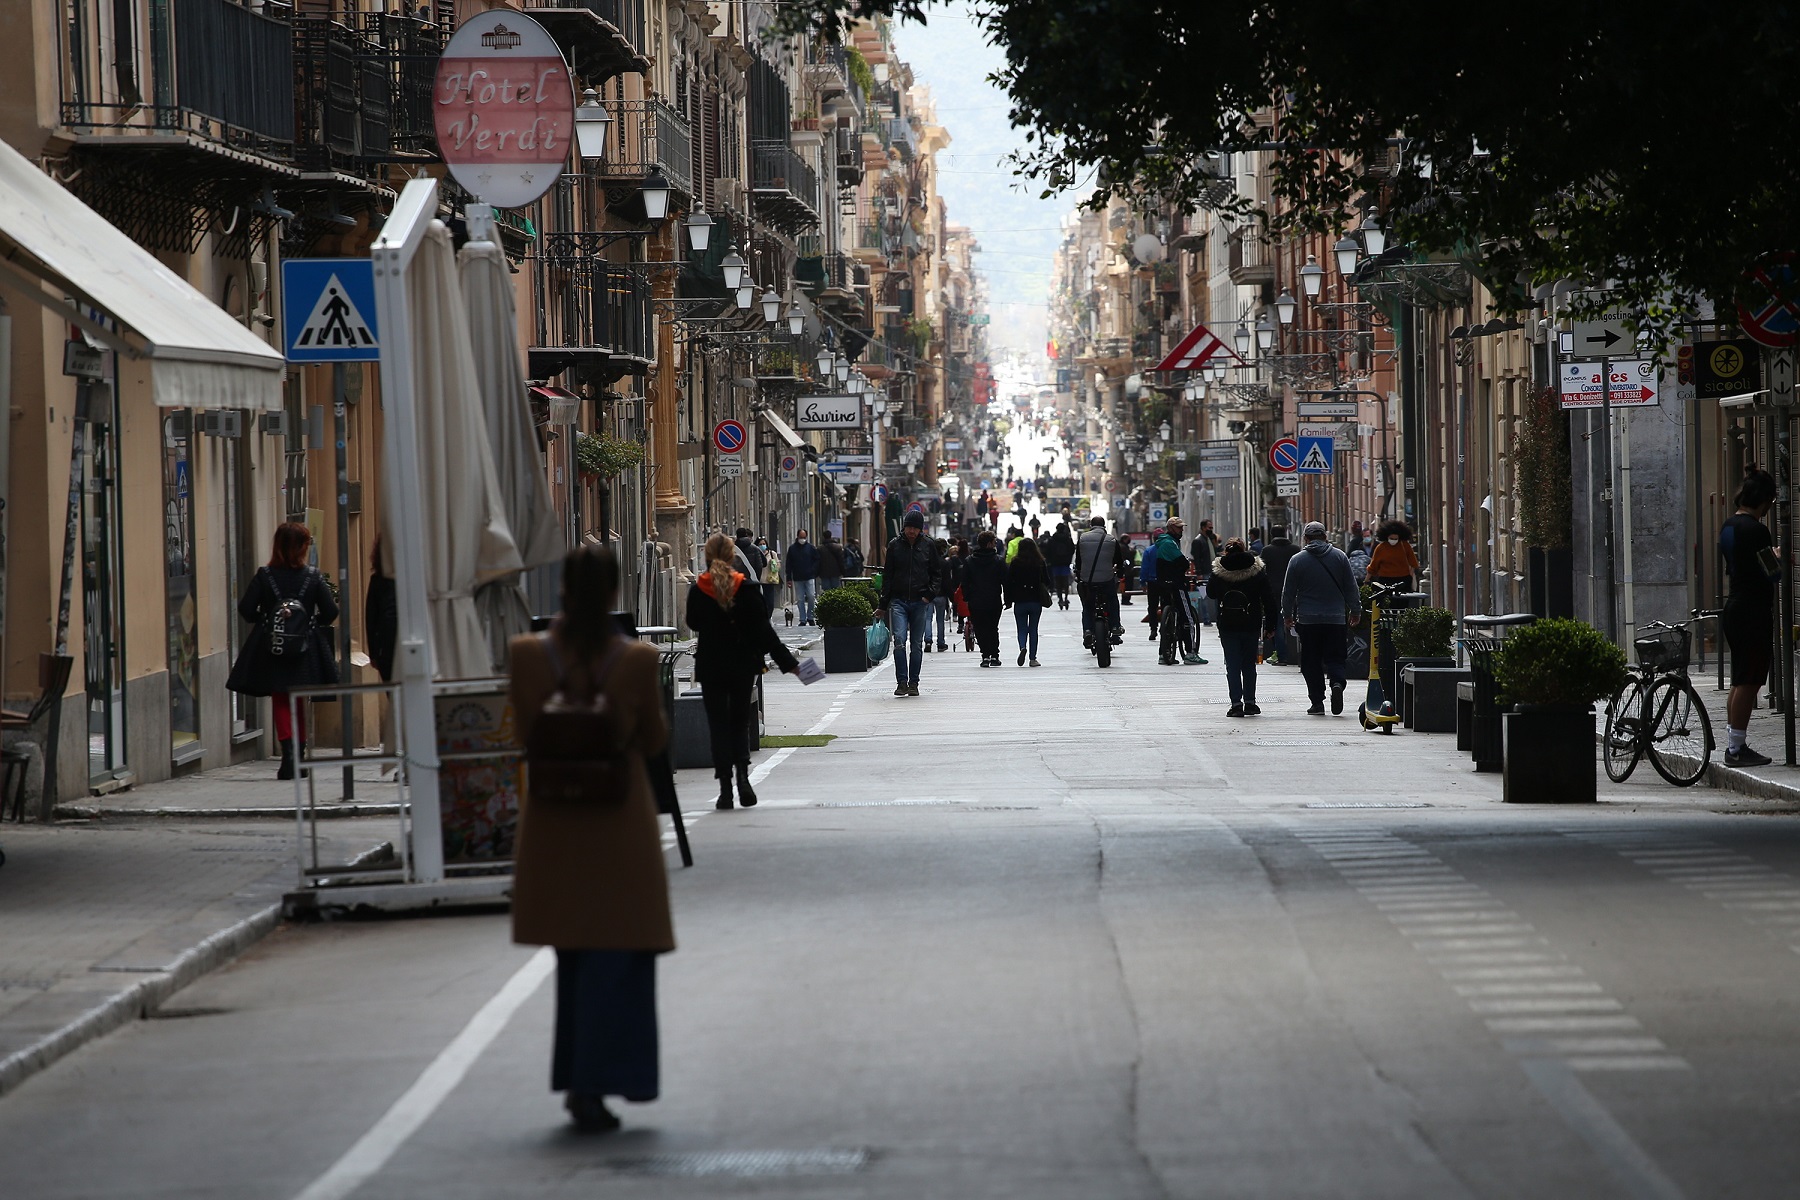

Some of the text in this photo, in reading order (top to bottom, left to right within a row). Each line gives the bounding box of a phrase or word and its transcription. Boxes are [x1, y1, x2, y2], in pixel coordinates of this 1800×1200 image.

[439, 67, 559, 105] Hotel
[447, 113, 558, 151] Verdi
[1591, 372, 1628, 384] aes
[800, 403, 856, 423] Laurino
[1300, 426, 1338, 437] Camilleri
